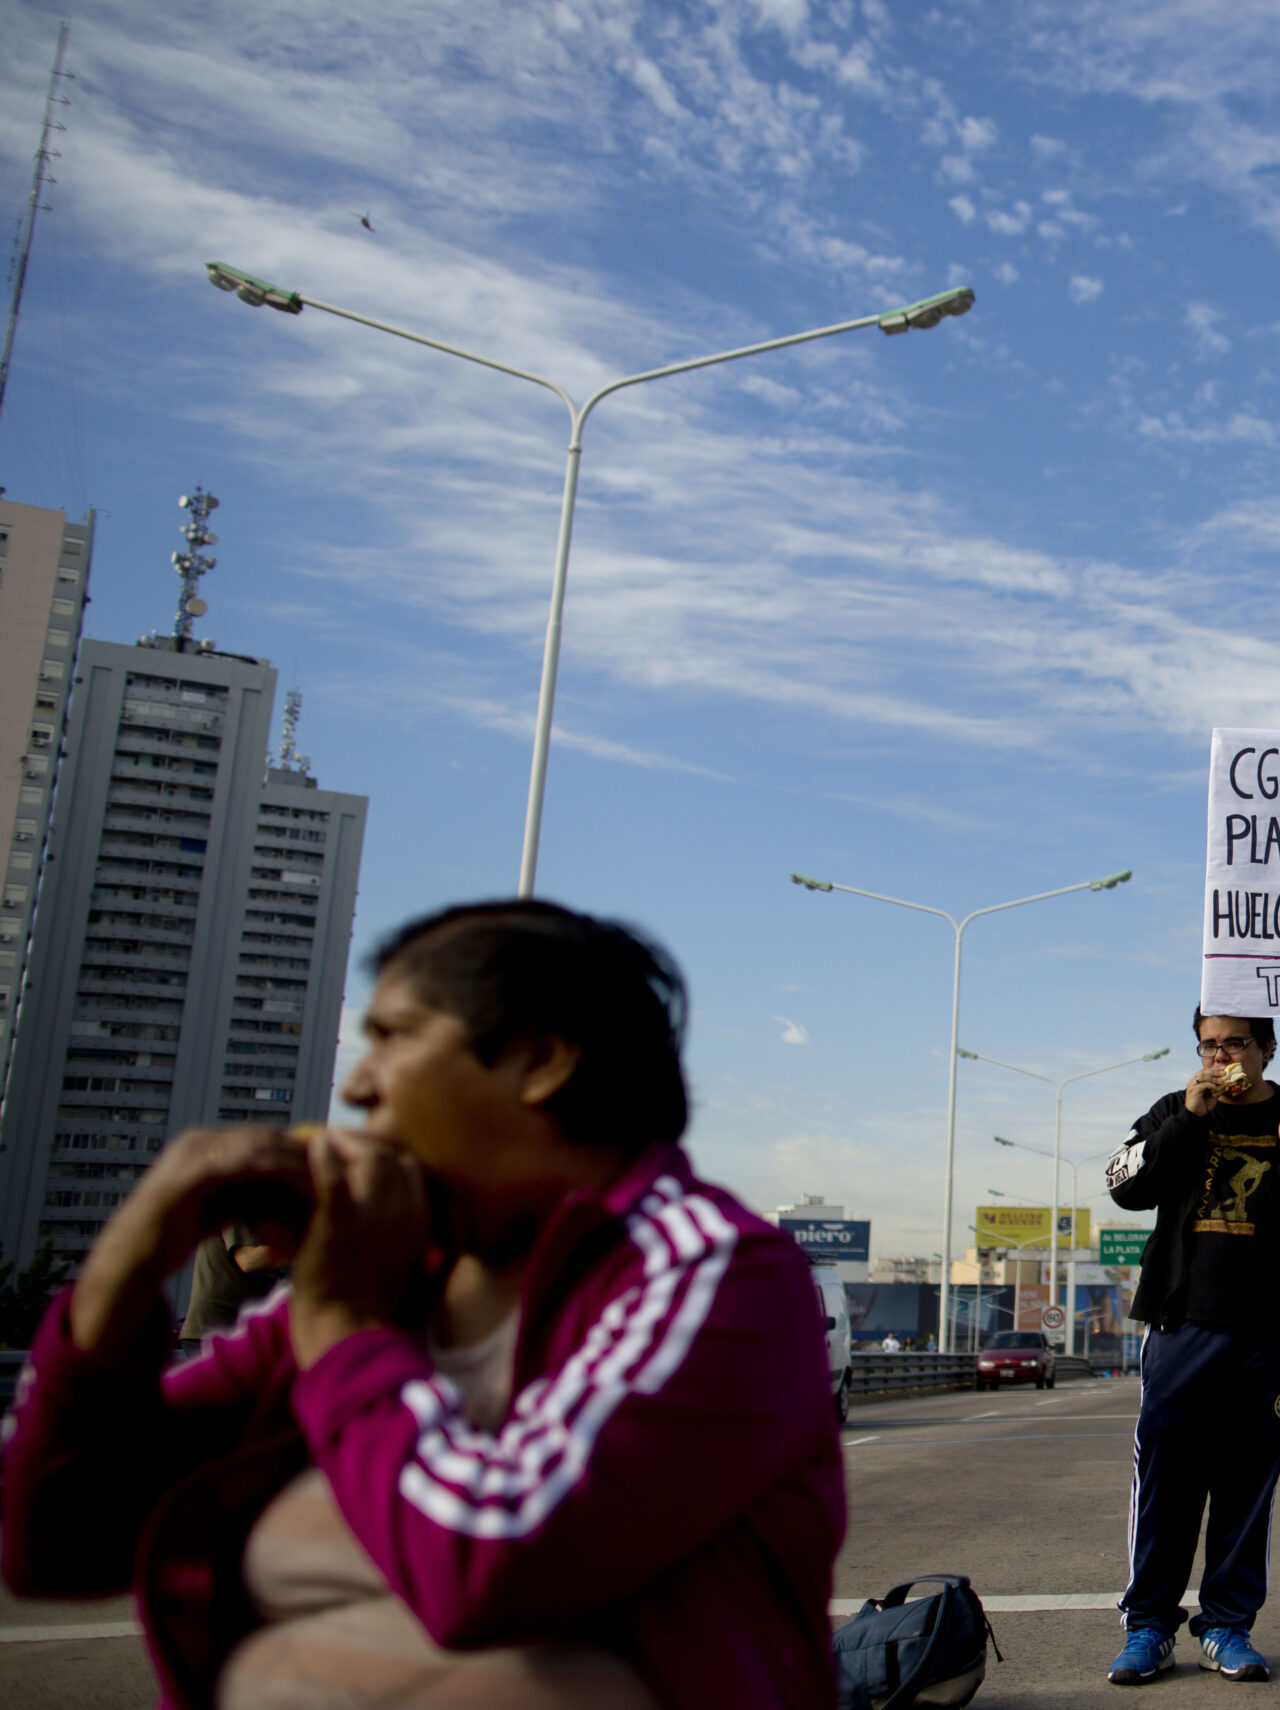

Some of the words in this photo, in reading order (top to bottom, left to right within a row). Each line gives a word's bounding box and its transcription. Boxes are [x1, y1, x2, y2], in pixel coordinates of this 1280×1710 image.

[793, 1224, 852, 1246] piero
[1113, 1233, 1150, 1241] BELGRAN
[1103, 1246, 1114, 1254] LA
[1115, 1246, 1141, 1254] PLATA
